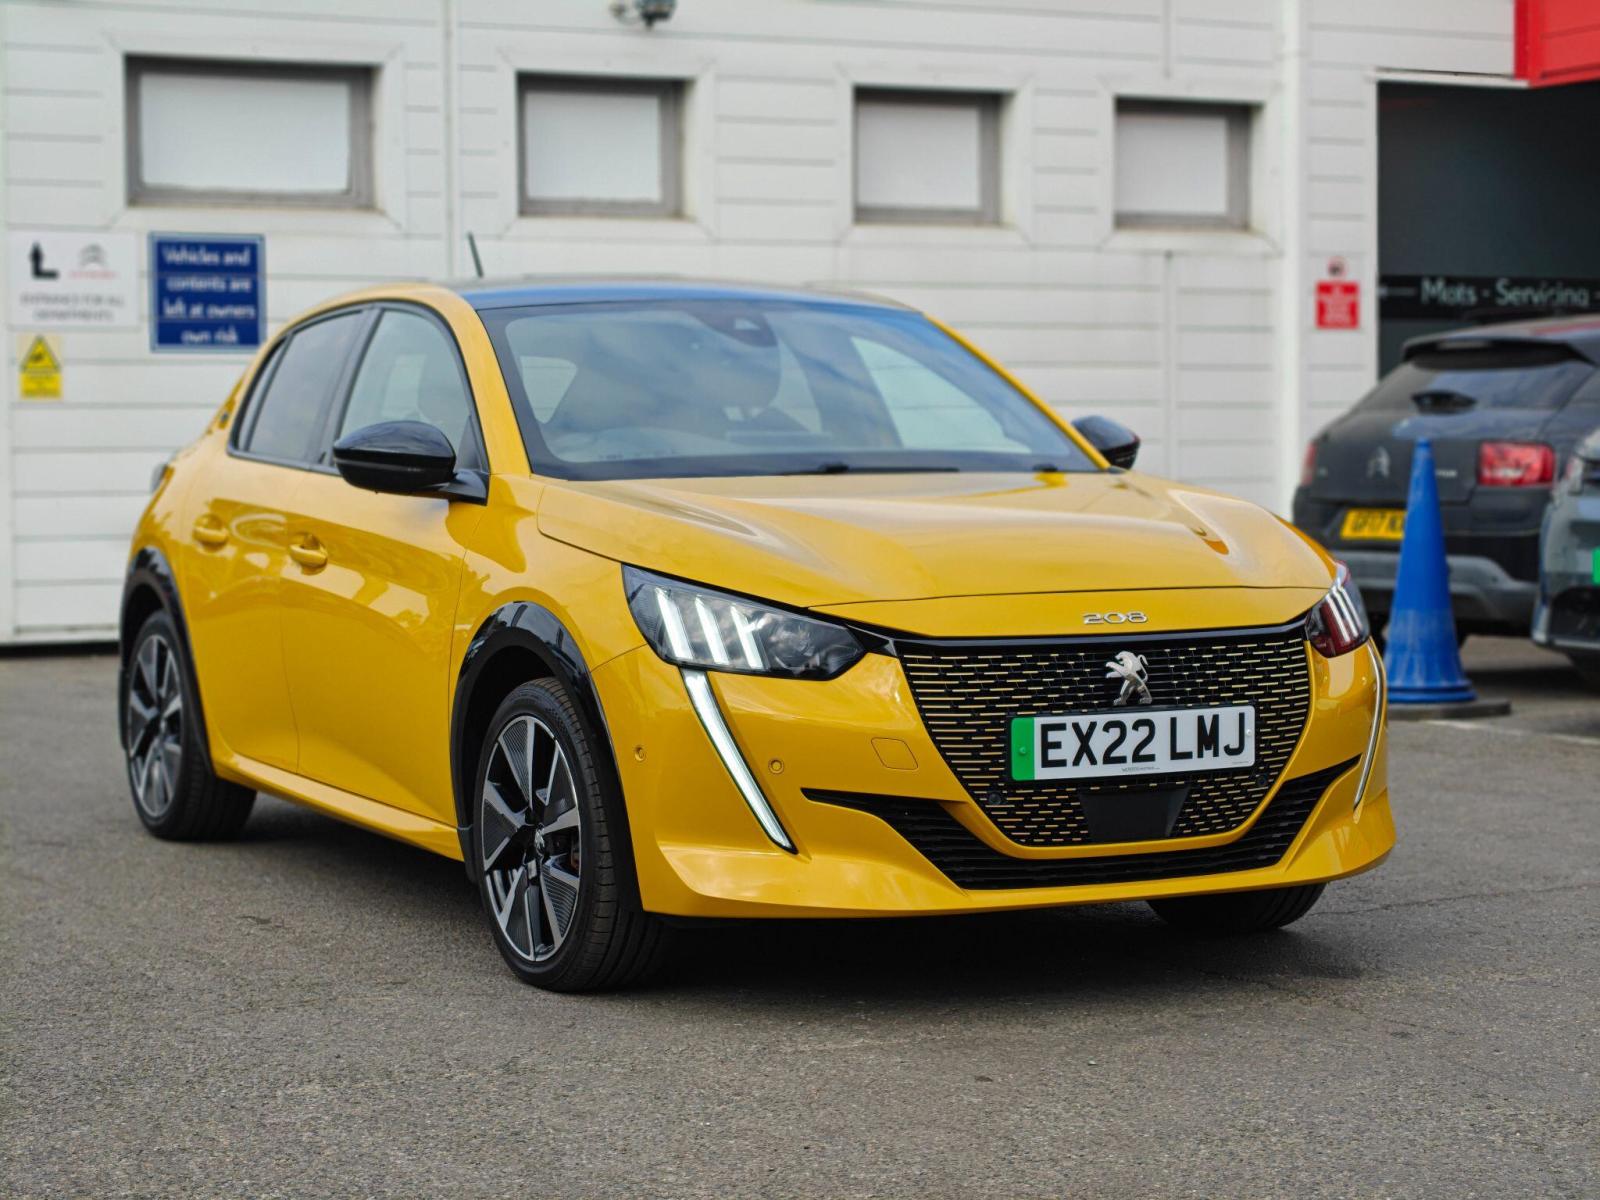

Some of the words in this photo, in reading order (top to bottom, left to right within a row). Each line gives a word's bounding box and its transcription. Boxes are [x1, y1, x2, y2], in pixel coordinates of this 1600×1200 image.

[162, 245, 220, 264] Vehicles
[223, 246, 250, 265] and
[167, 275, 226, 291] contents
[229, 278, 252, 292] are
[1496, 278, 1590, 307] Servicing
[163, 297, 186, 317] left
[189, 302, 204, 318] at
[207, 304, 256, 318] owners
[181, 330, 211, 342] own
[214, 325, 239, 342] risk
[1082, 611, 1148, 625] 208
[1040, 718, 1156, 768] EX22
[1169, 712, 1245, 760] LMJ
